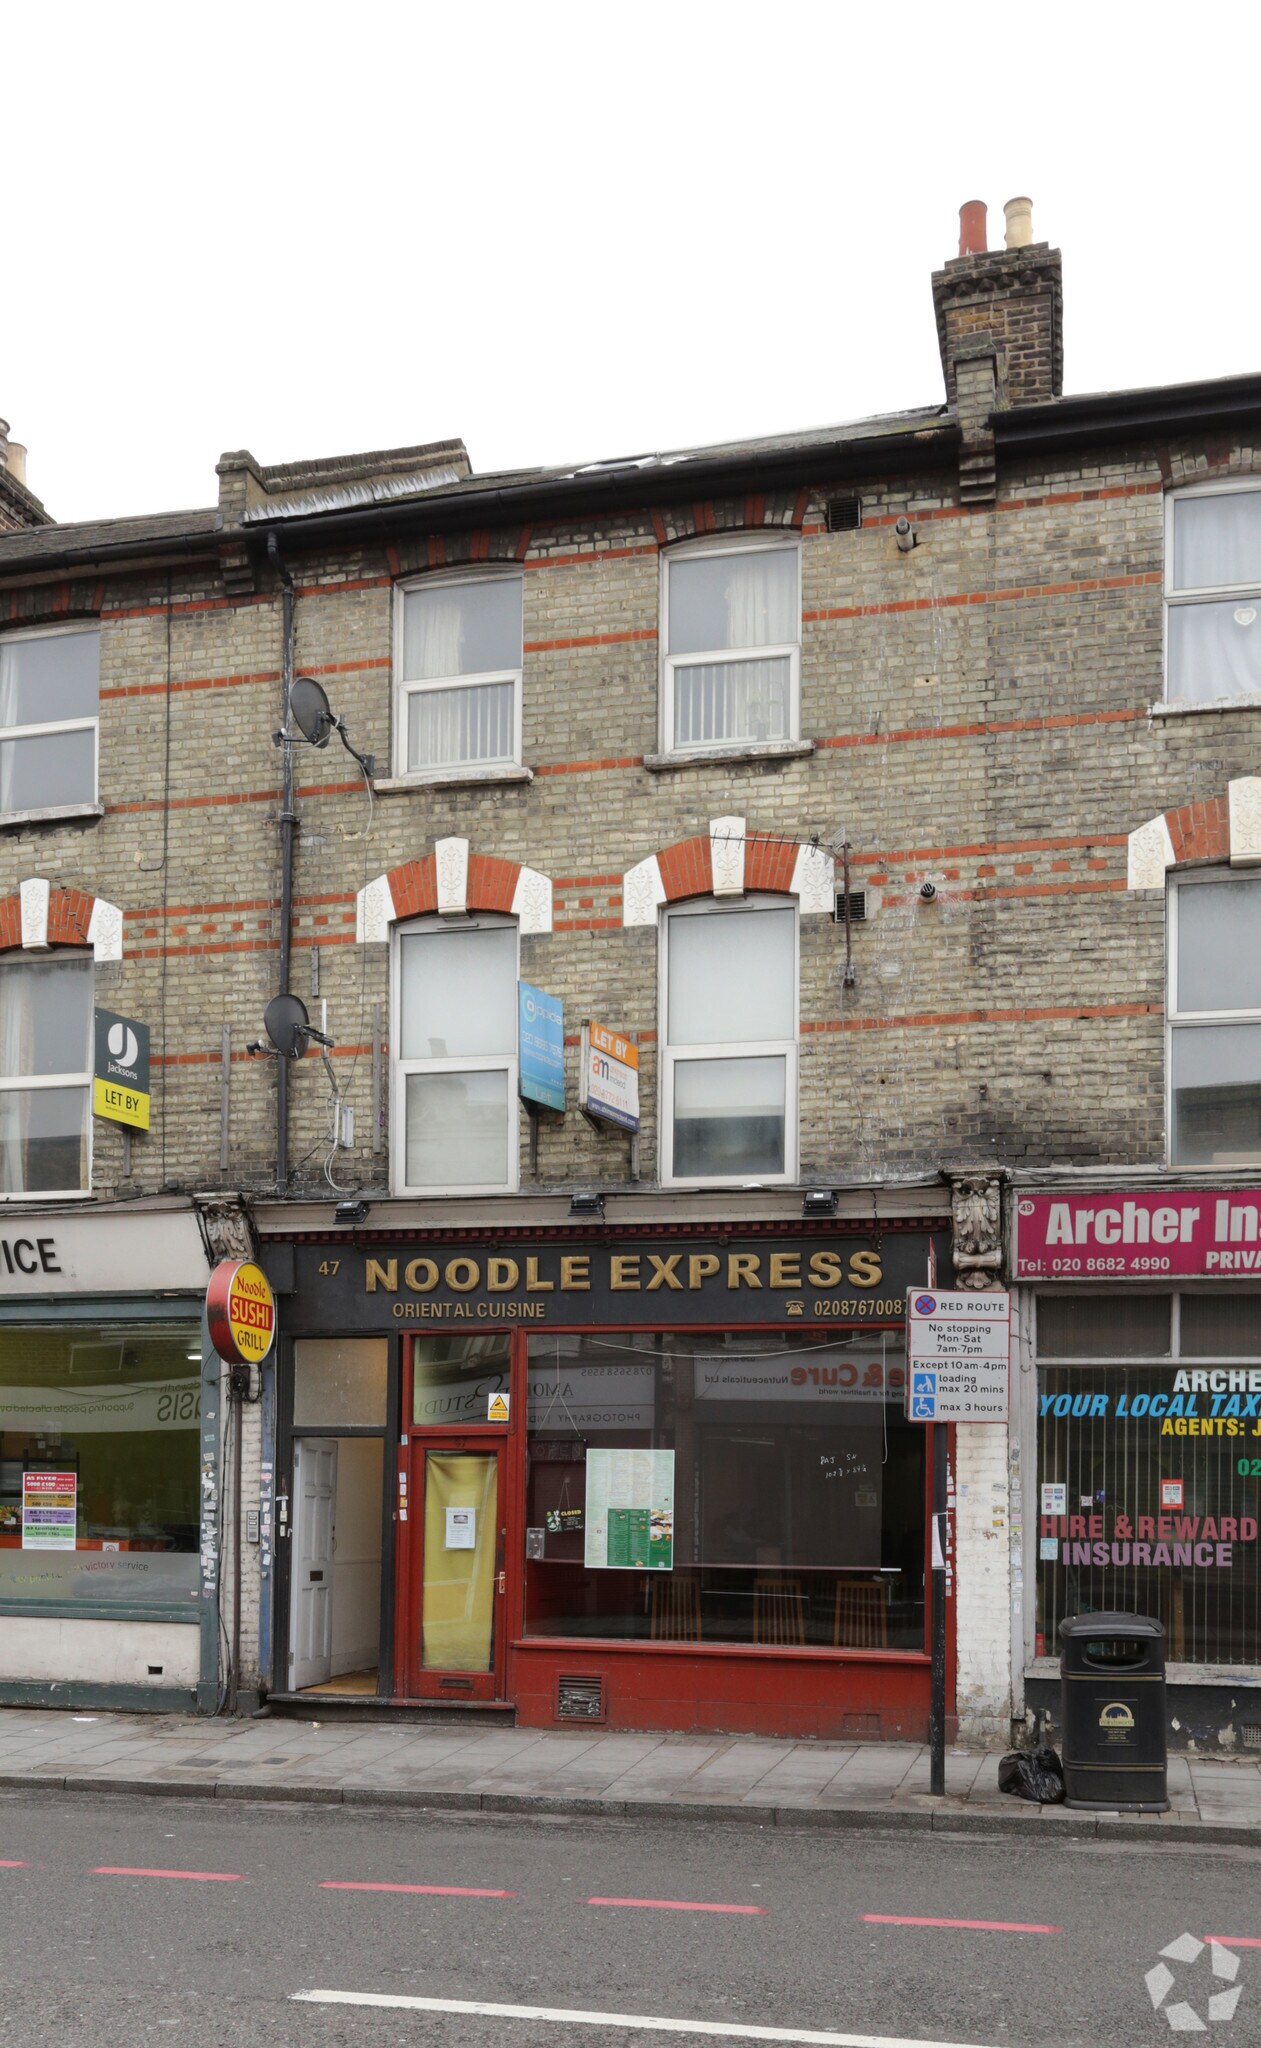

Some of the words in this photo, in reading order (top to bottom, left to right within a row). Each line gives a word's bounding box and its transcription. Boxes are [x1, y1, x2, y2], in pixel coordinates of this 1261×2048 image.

[594, 1027, 613, 1051] LET
[615, 1040, 628, 1060] BY
[107, 1061, 139, 1081] Jacksons
[106, 1089, 122, 1107] LET
[126, 1095, 140, 1112] BY
[1020, 1203, 1033, 1214] 49
[1045, 1201, 1200, 1245] Archer
[1215, 1199, 1261, 1242] In
[318, 1260, 340, 1276] 47
[365, 1256, 591, 1292] NOODLE
[610, 1251, 883, 1291] EXPRESS
[1018, 1259, 1047, 1271] Tel:
[1052, 1258, 1081, 1271] 020
[1086, 1258, 1125, 1270] 8682
[1131, 1257, 1170, 1270] 4990
[237, 1276, 266, 1299] Noodle
[231, 1298, 269, 1328] SUSHI
[392, 1302, 473, 1318] ORIENTAL
[477, 1302, 545, 1318] CUISINE
[940, 1302, 963, 1311] RED
[967, 1302, 1005, 1312] ROUTE
[928, 1324, 943, 1333] No
[947, 1325, 991, 1334] stopping
[237, 1330, 264, 1351] GRILL
[937, 1334, 981, 1343] Mon-Sat
[937, 1344, 983, 1354] 7am-7pm
[913, 1360, 948, 1370] Except
[939, 1374, 977, 1384] loading
[939, 1385, 960, 1393] max
[963, 1385, 978, 1393] 20
[980, 1385, 1004, 1393] mins
[940, 1403, 961, 1411] max
[965, 1403, 972, 1411] 3
[974, 1403, 1003, 1411] hours
[1040, 1394, 1109, 1417] YOUR
[1115, 1394, 1198, 1417] LOCAL
[1161, 1418, 1245, 1436] AGENTS:
[1040, 1515, 1103, 1539] HIRE
[1113, 1515, 1134, 1539] &
[1138, 1516, 1258, 1541] REWARD
[1062, 1542, 1233, 1567] INSURANCE
[86, 1560, 115, 1571] victory
[117, 1562, 150, 1571] service
